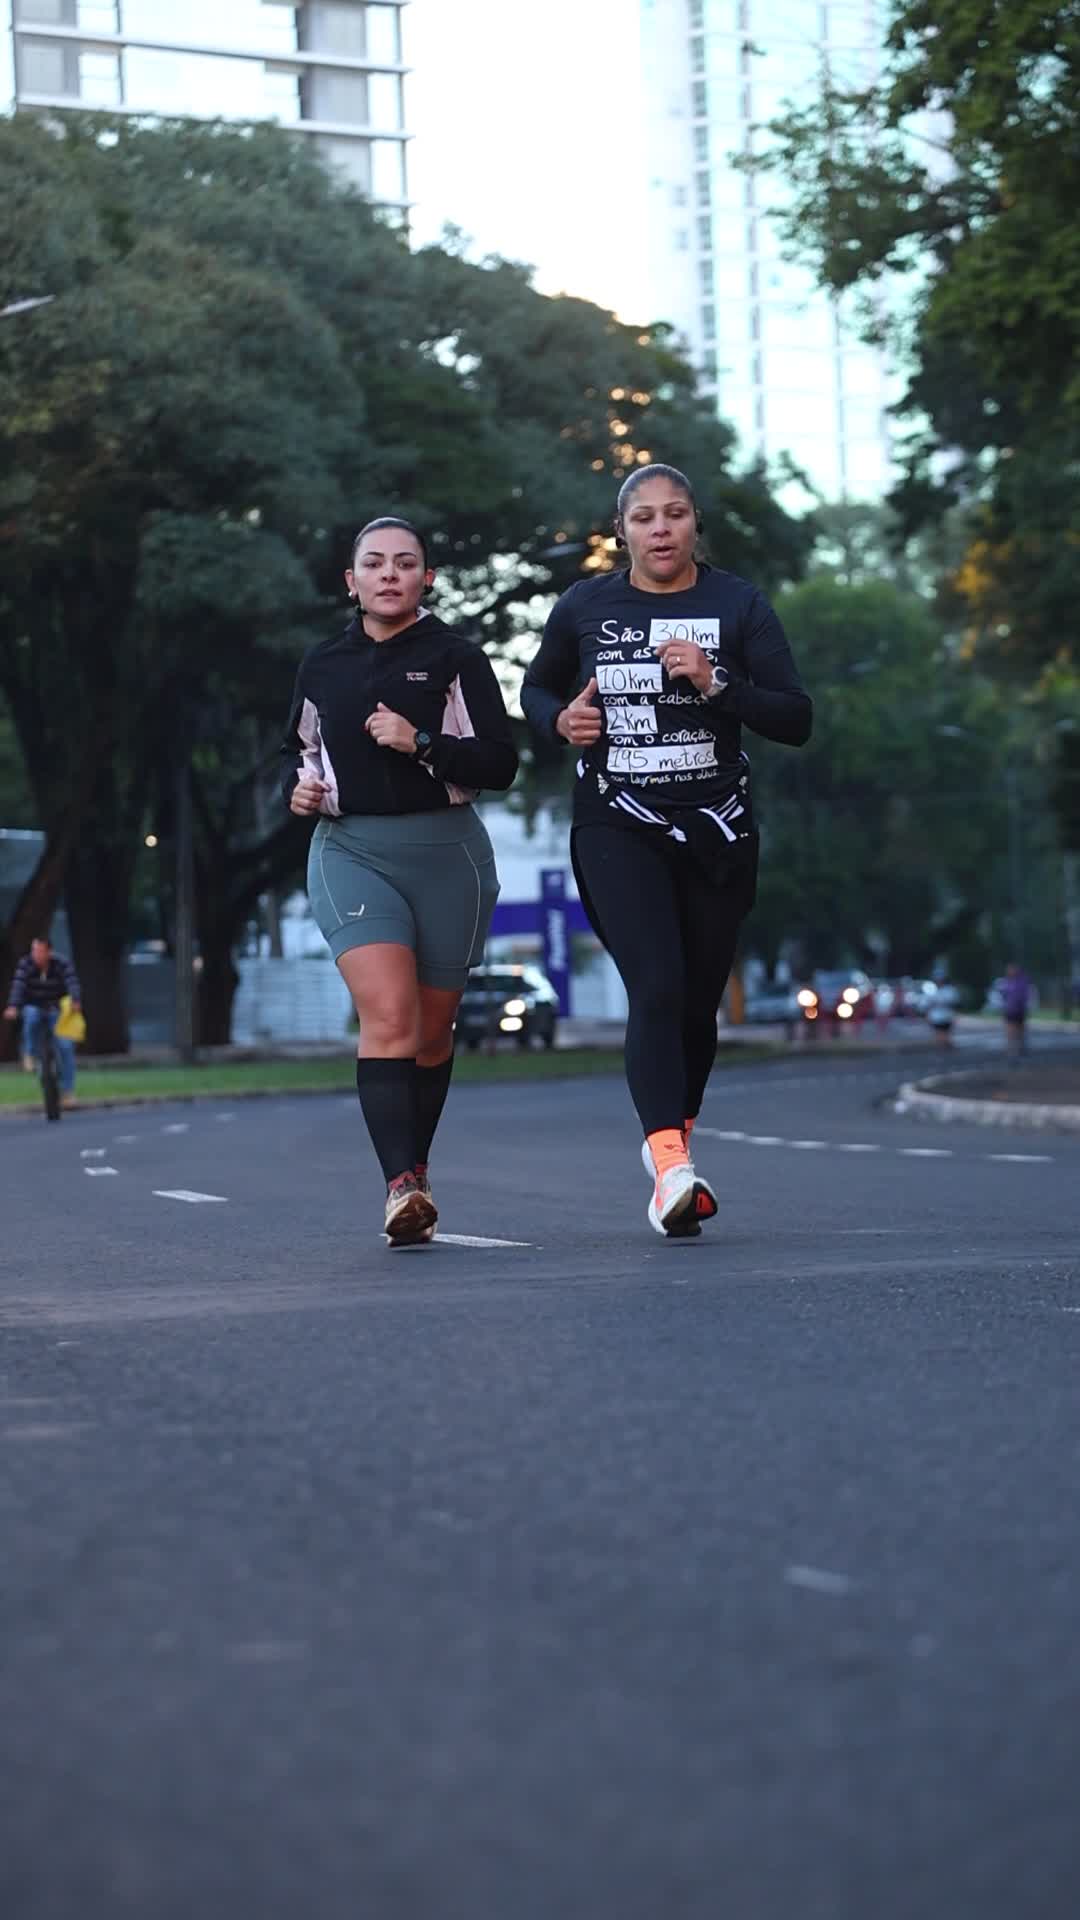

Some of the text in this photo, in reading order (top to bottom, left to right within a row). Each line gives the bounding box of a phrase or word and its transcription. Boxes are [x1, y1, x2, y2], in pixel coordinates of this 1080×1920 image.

[597, 620, 718, 647] São 30km
[597, 648, 651, 661] com as
[599, 667, 659, 692] 10km
[603, 696, 629, 706] com
[640, 695, 649, 705] a
[609, 708, 655, 731] 2km
[645, 735, 654, 744] o
[610, 747, 714, 771] 195 metros
[675, 774, 693, 782] nos
